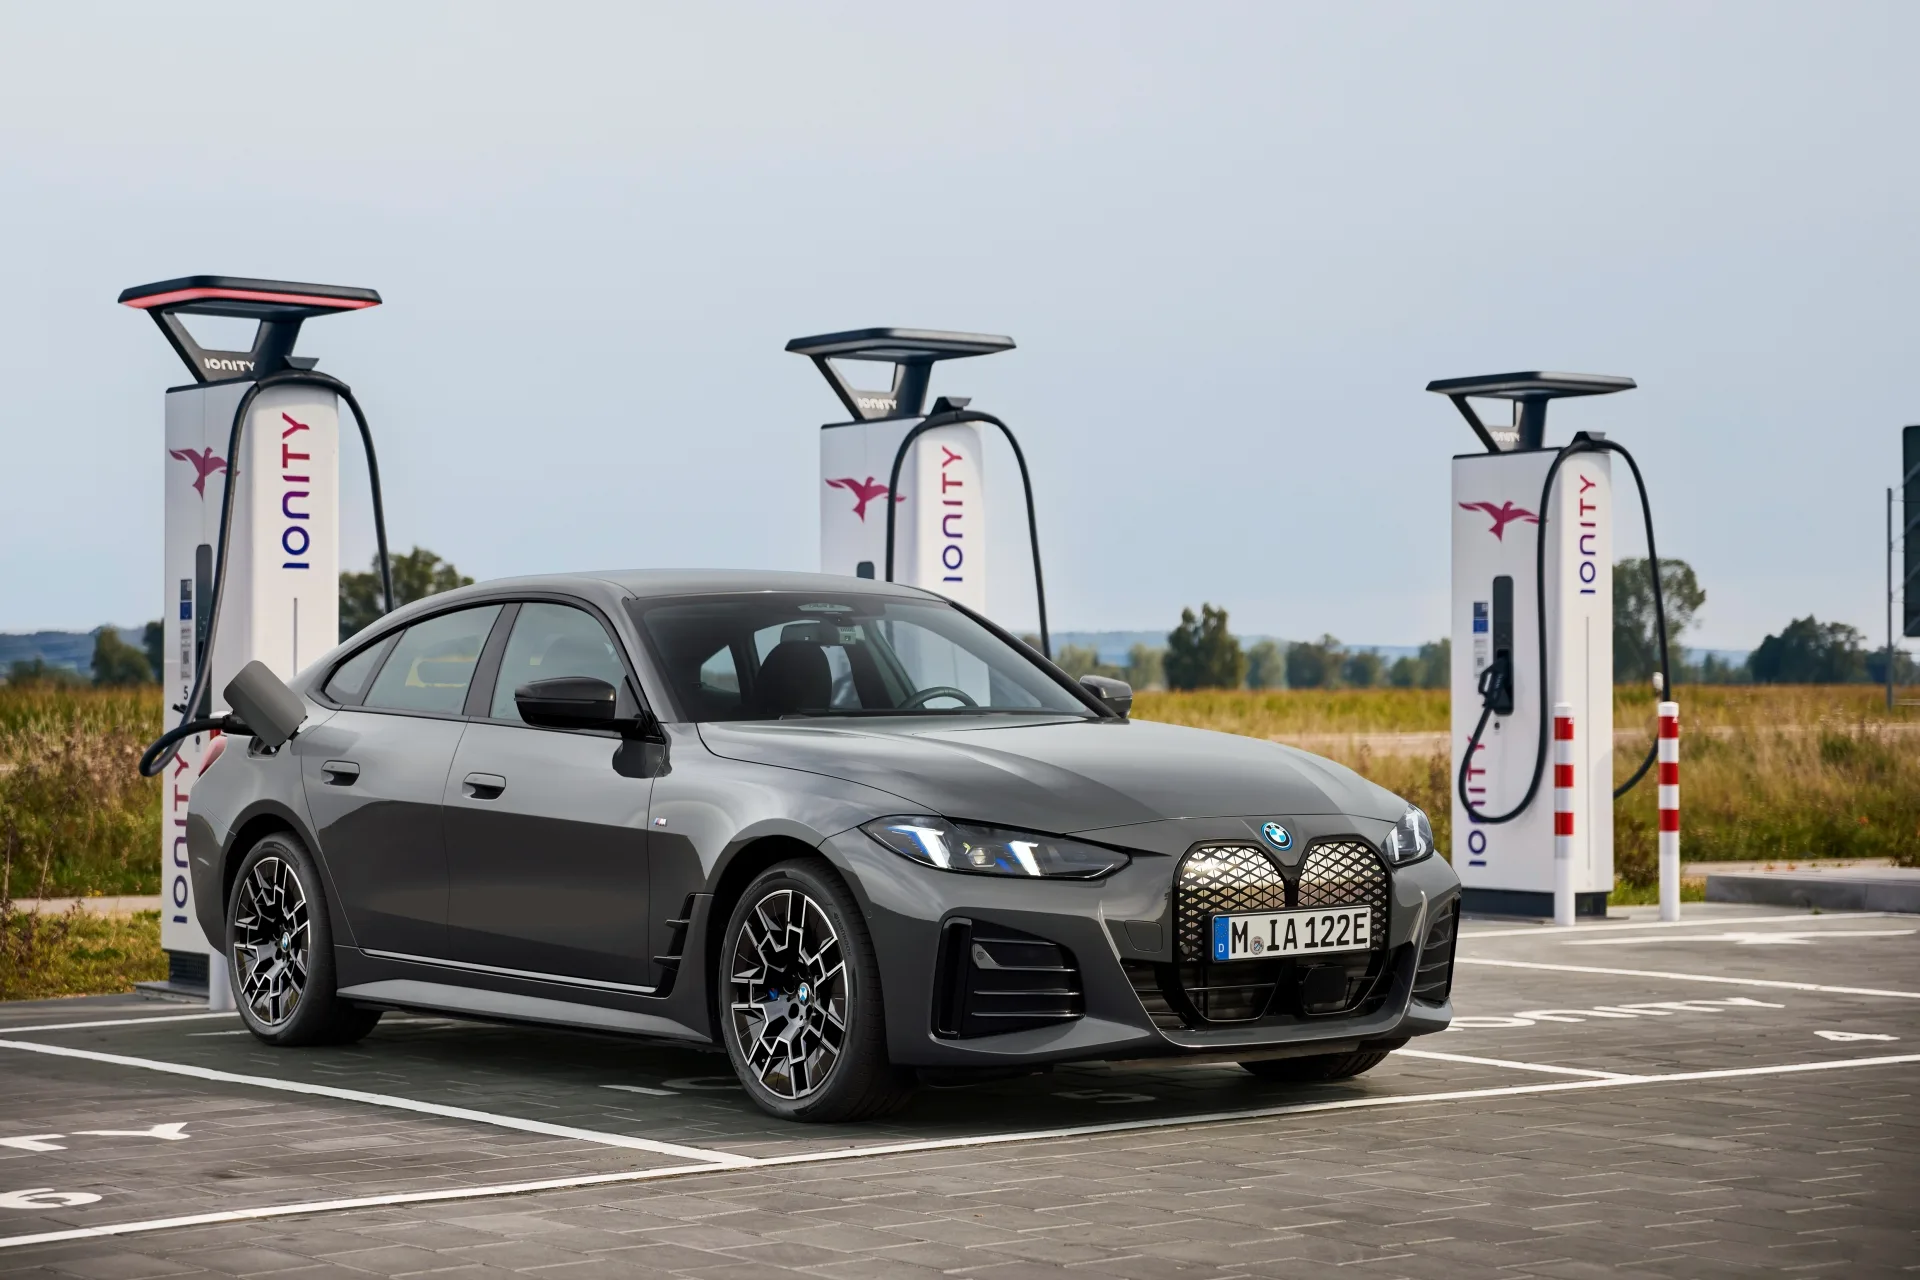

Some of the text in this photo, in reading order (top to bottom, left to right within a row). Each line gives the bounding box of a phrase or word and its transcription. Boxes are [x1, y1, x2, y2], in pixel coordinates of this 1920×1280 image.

[203, 357, 255, 372] IONITY
[282, 411, 310, 569] IONITY
[942, 445, 963, 582] IONITY
[1579, 474, 1596, 595] IONITY
[1218, 943, 1225, 953] D
[1231, 912, 1368, 953] M IA 122E
[1448, 997, 1785, 1032] ONITY
